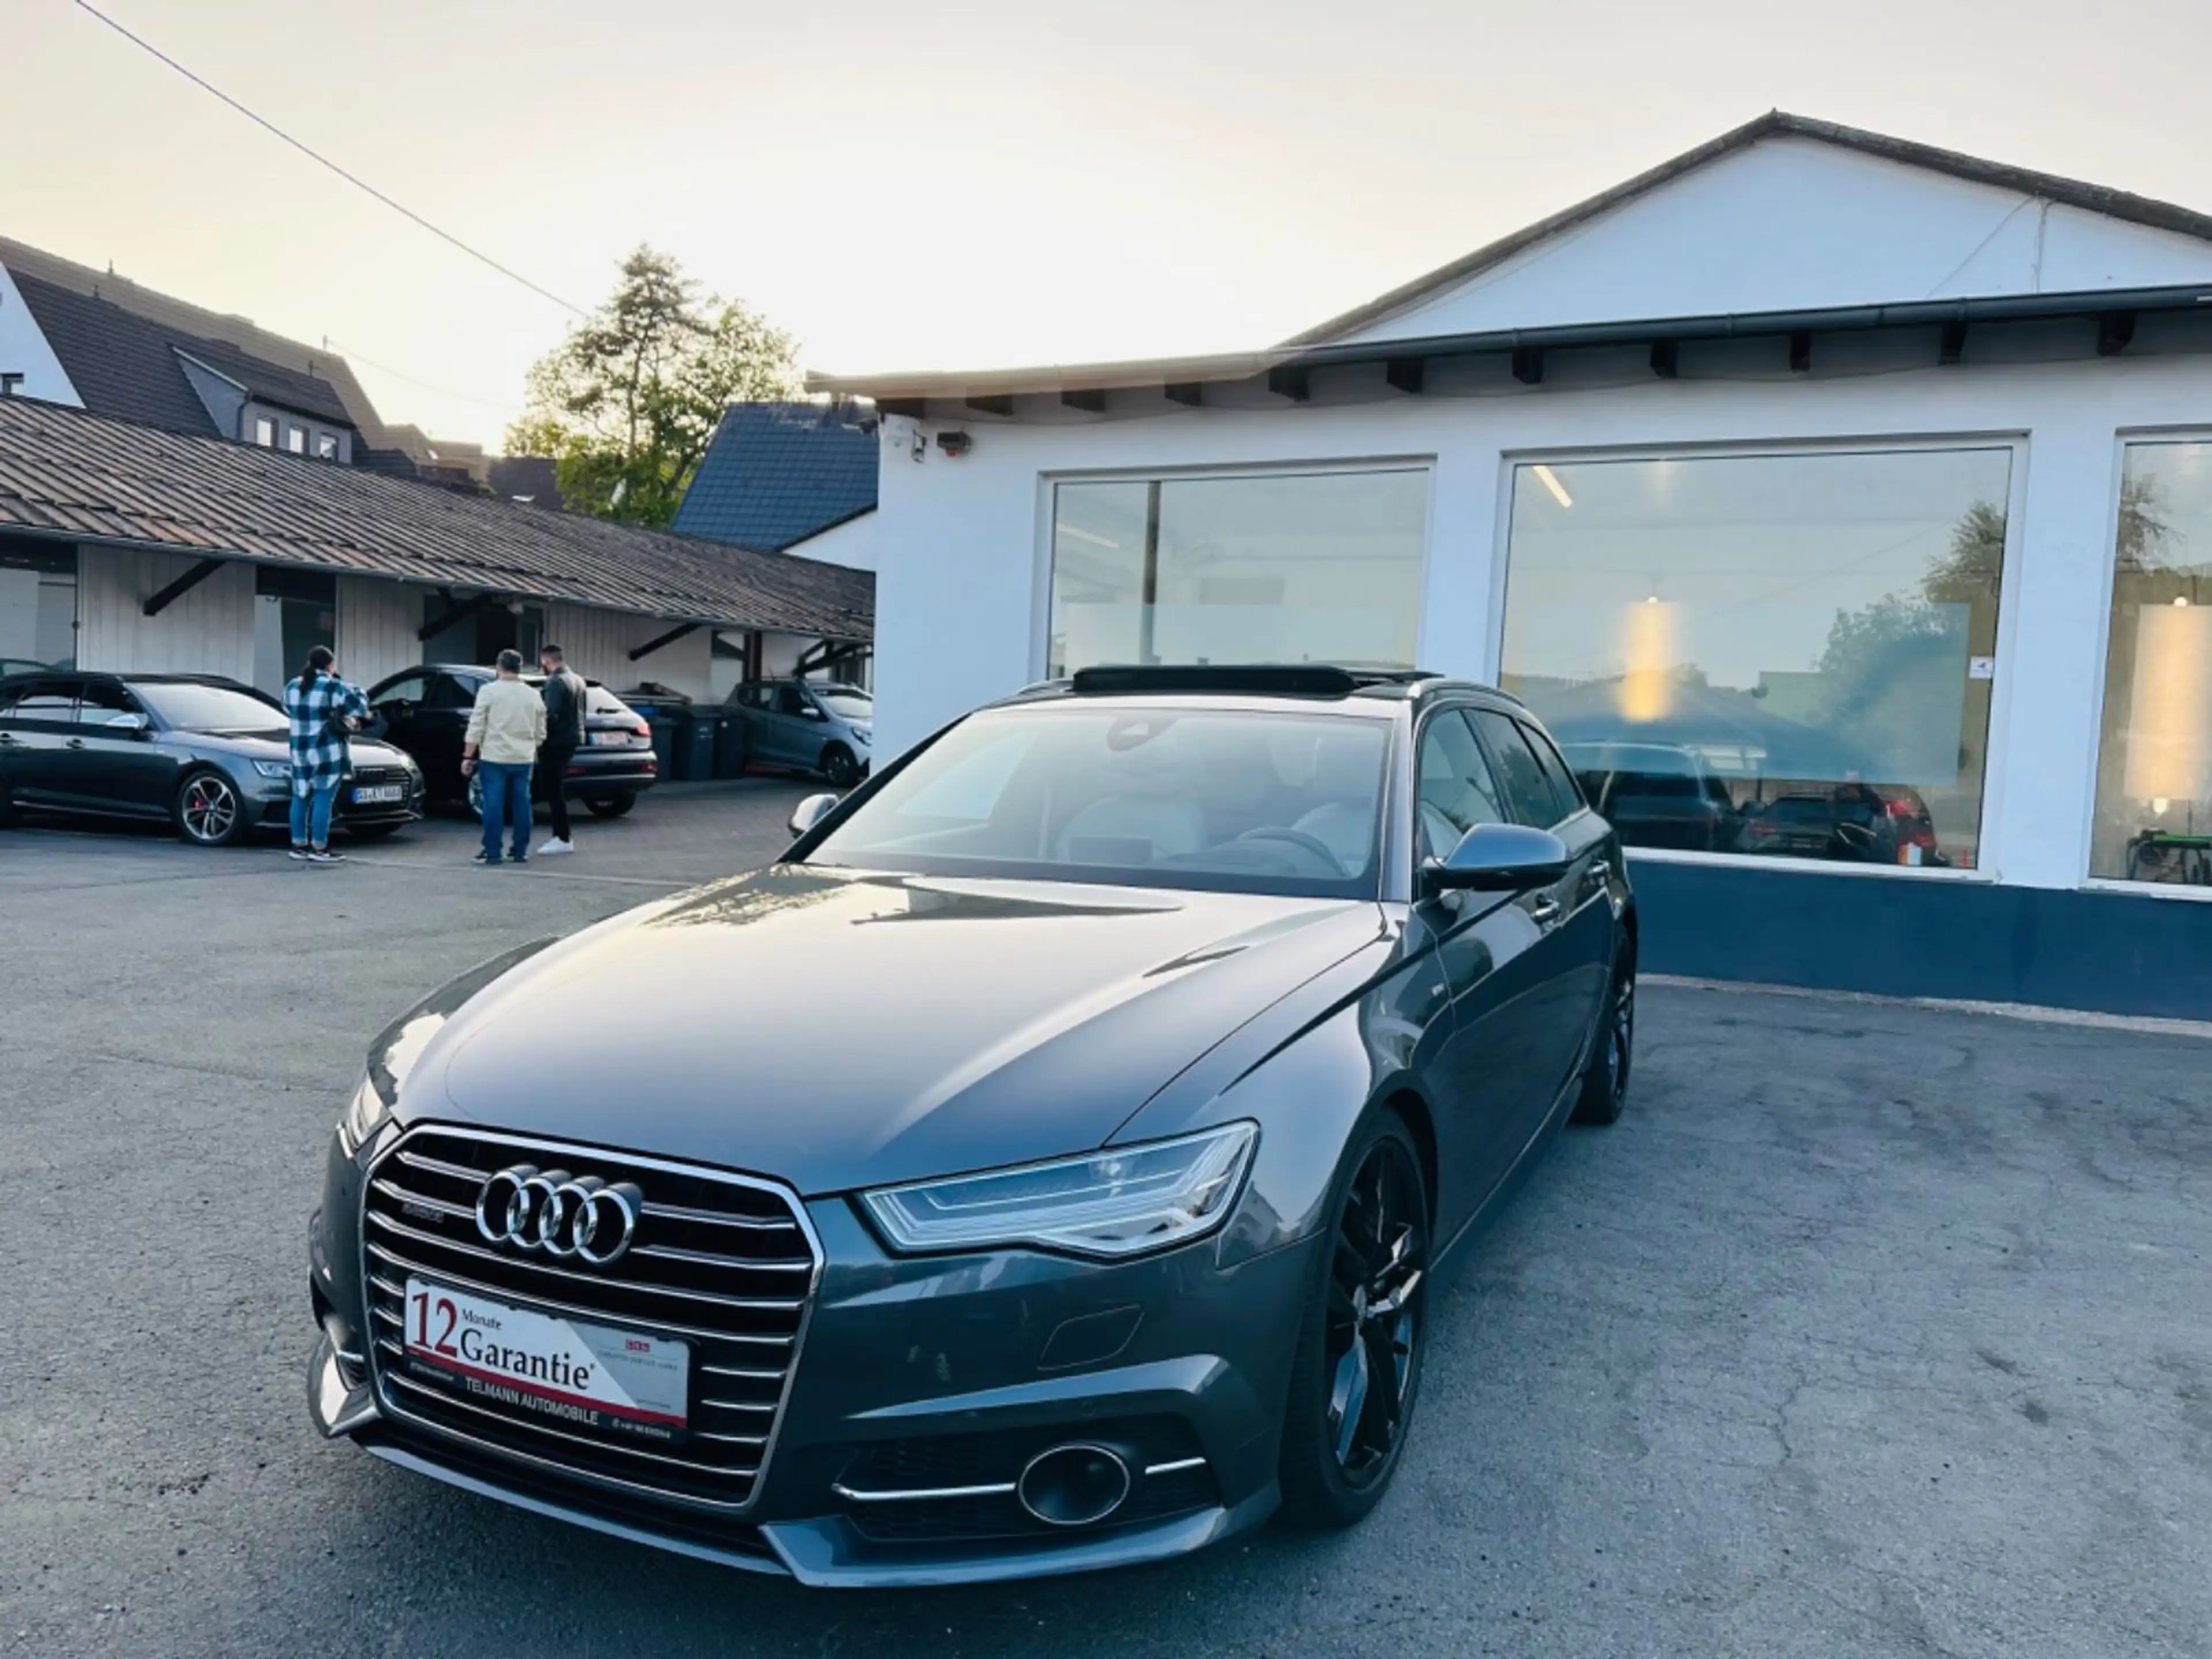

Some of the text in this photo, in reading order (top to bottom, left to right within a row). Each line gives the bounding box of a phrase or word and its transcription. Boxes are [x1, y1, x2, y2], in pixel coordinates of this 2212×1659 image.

[411, 1292, 458, 1358] 12
[463, 1308, 502, 1330] Monate
[465, 1376, 599, 1425] TELMANN AUTOMOBILE
